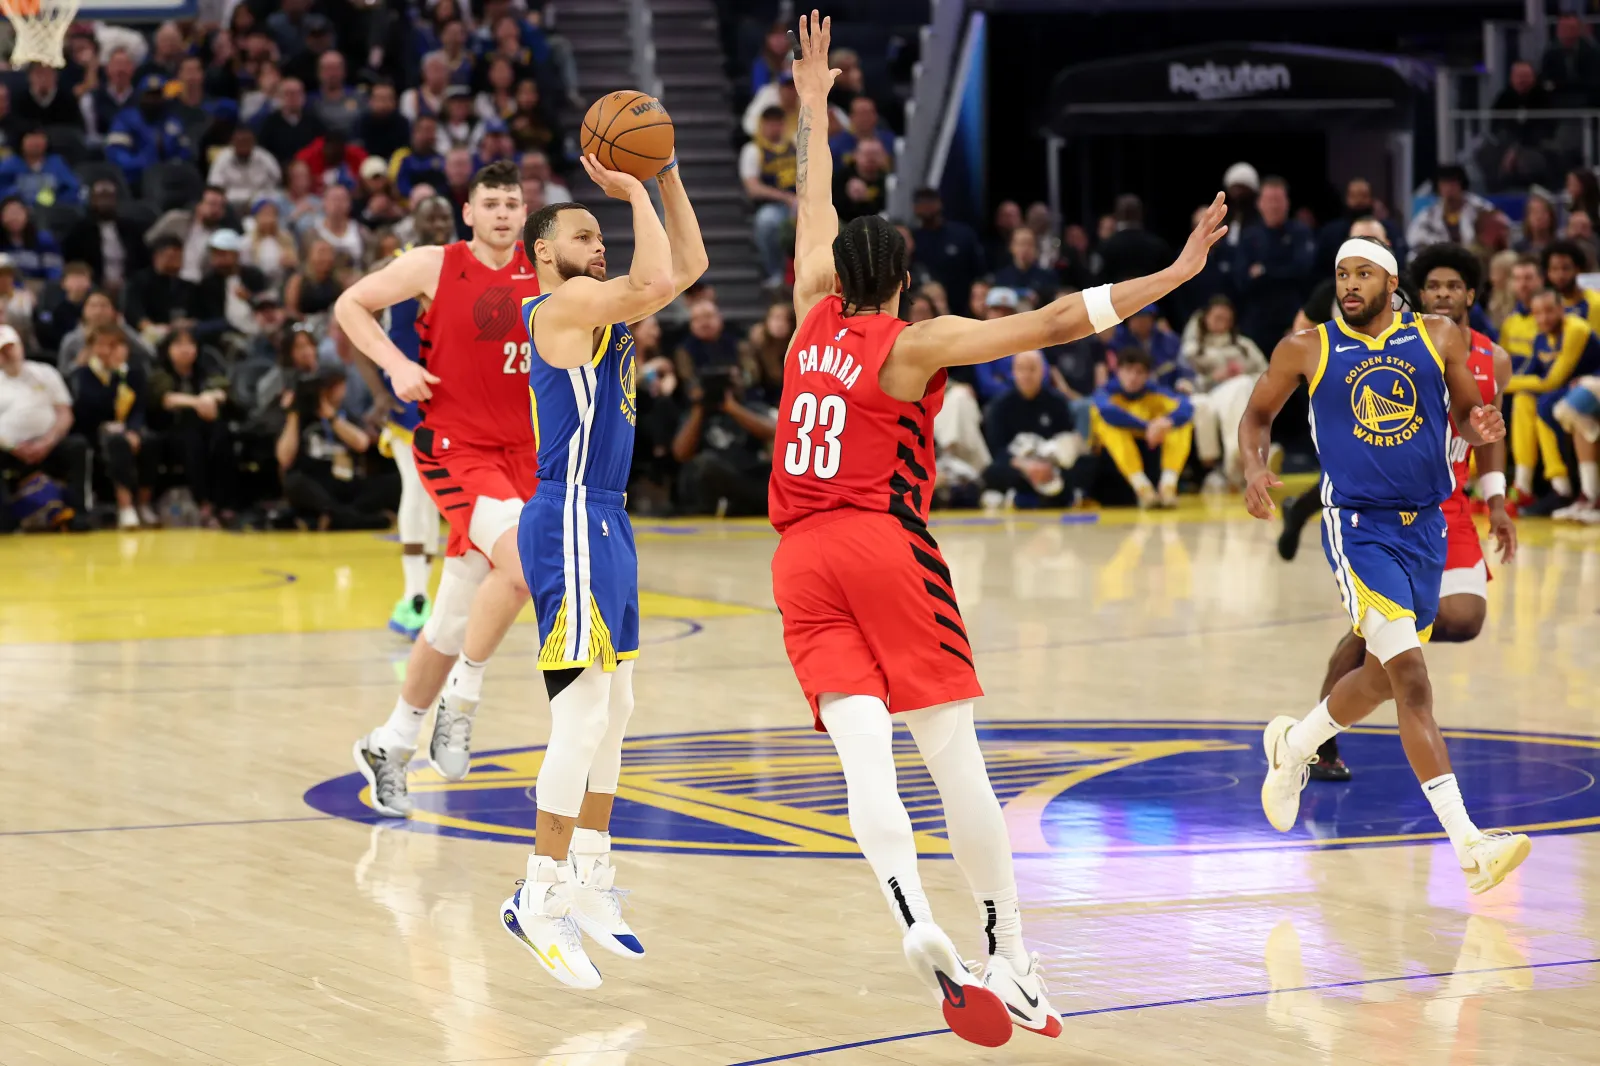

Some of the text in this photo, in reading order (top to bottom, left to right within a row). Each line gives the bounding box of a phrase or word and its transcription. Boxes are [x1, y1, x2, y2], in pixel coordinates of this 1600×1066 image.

[1169, 61, 1290, 97] Rakuten
[1389, 334, 1418, 346] Rakuten
[503, 341, 532, 374] 23
[798, 345, 862, 390] CAMARA
[1345, 356, 1416, 384] GOLDEN STATE
[1391, 380, 1404, 399] 4
[784, 392, 847, 479] 33
[1353, 415, 1424, 447] WARRIORS
